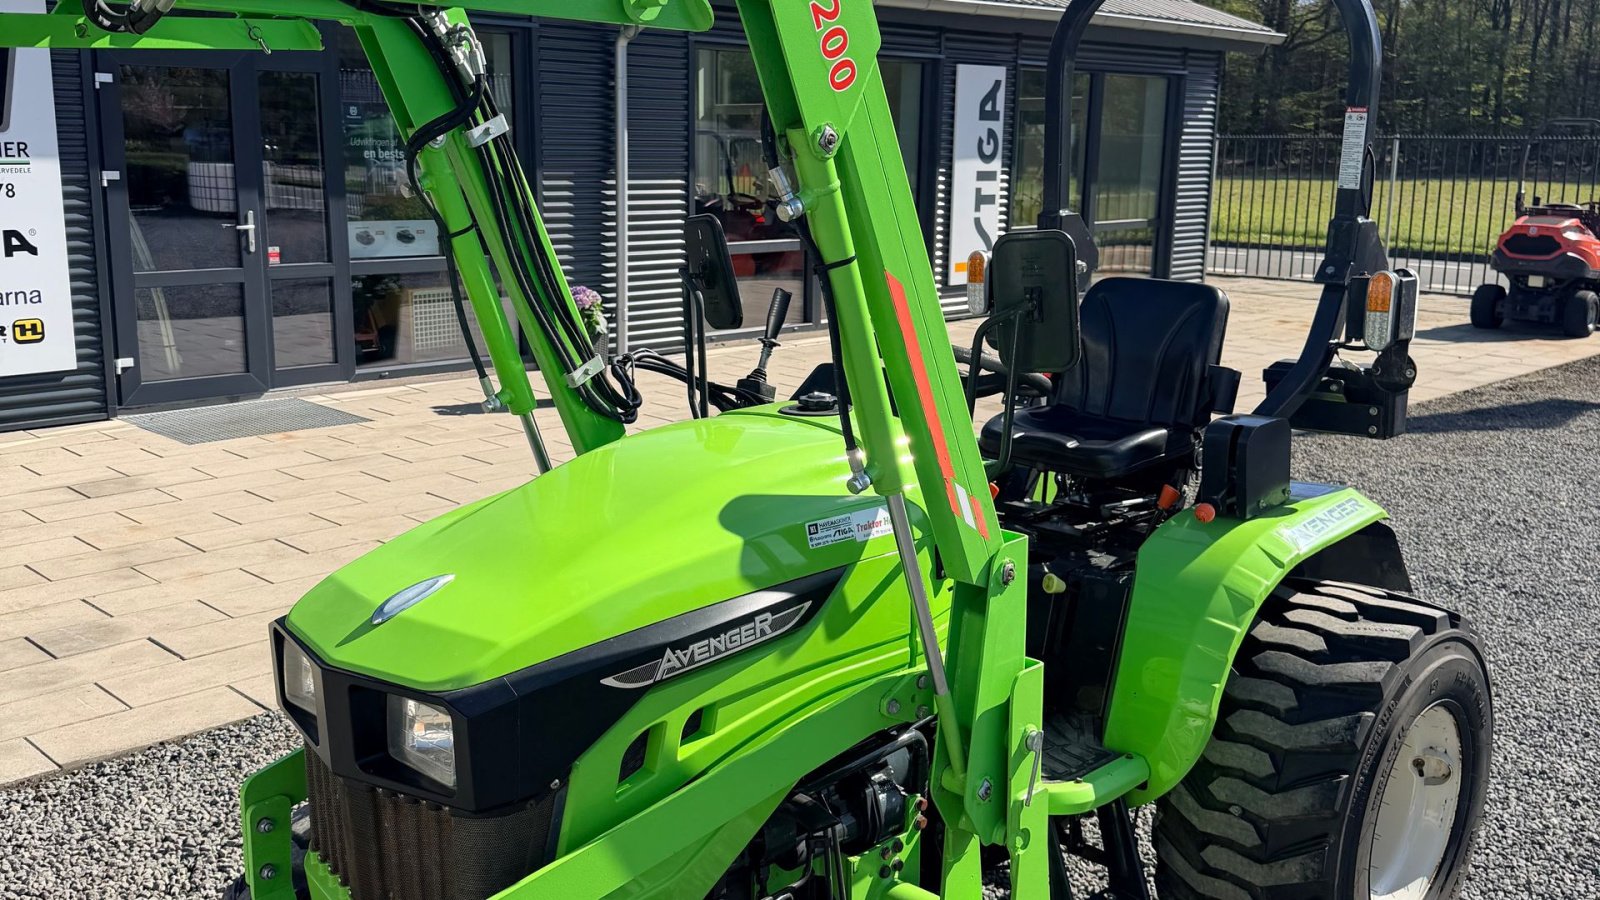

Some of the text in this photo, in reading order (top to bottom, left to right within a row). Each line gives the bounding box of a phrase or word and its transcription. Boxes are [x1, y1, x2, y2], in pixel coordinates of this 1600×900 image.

[363, 149, 376, 159] en
[856, 519, 882, 532] Traktor
[655, 612, 773, 682] AVENGER
